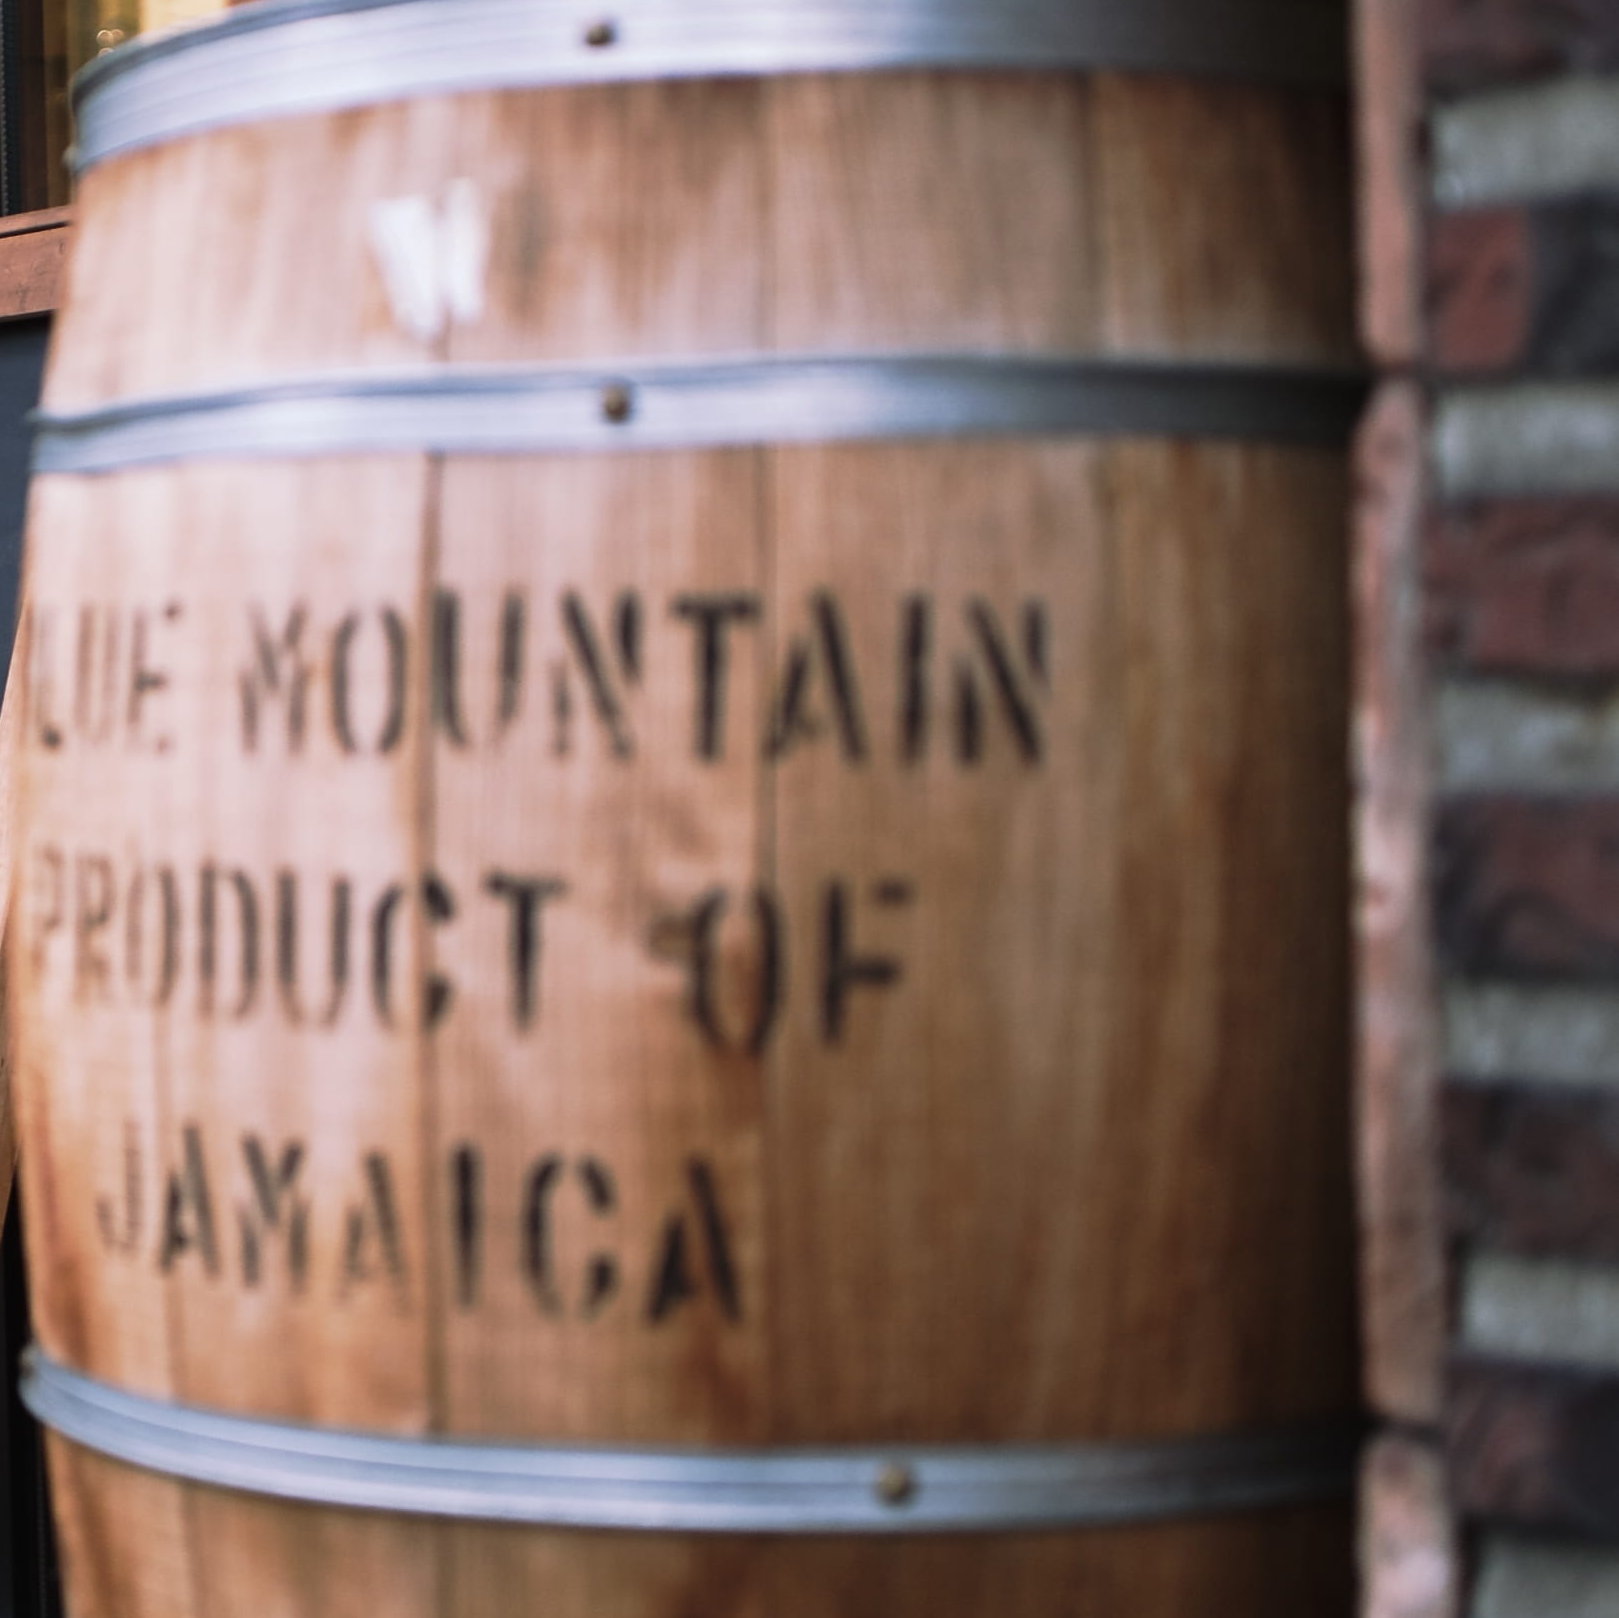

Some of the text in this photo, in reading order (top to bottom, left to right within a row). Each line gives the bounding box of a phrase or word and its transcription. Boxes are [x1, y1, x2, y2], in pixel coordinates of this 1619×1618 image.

[21, 585, 1054, 768] LUE MOUNTAIN
[30, 837, 917, 1059] PRODUCT OF
[95, 1118, 745, 1330] JAMAICA
